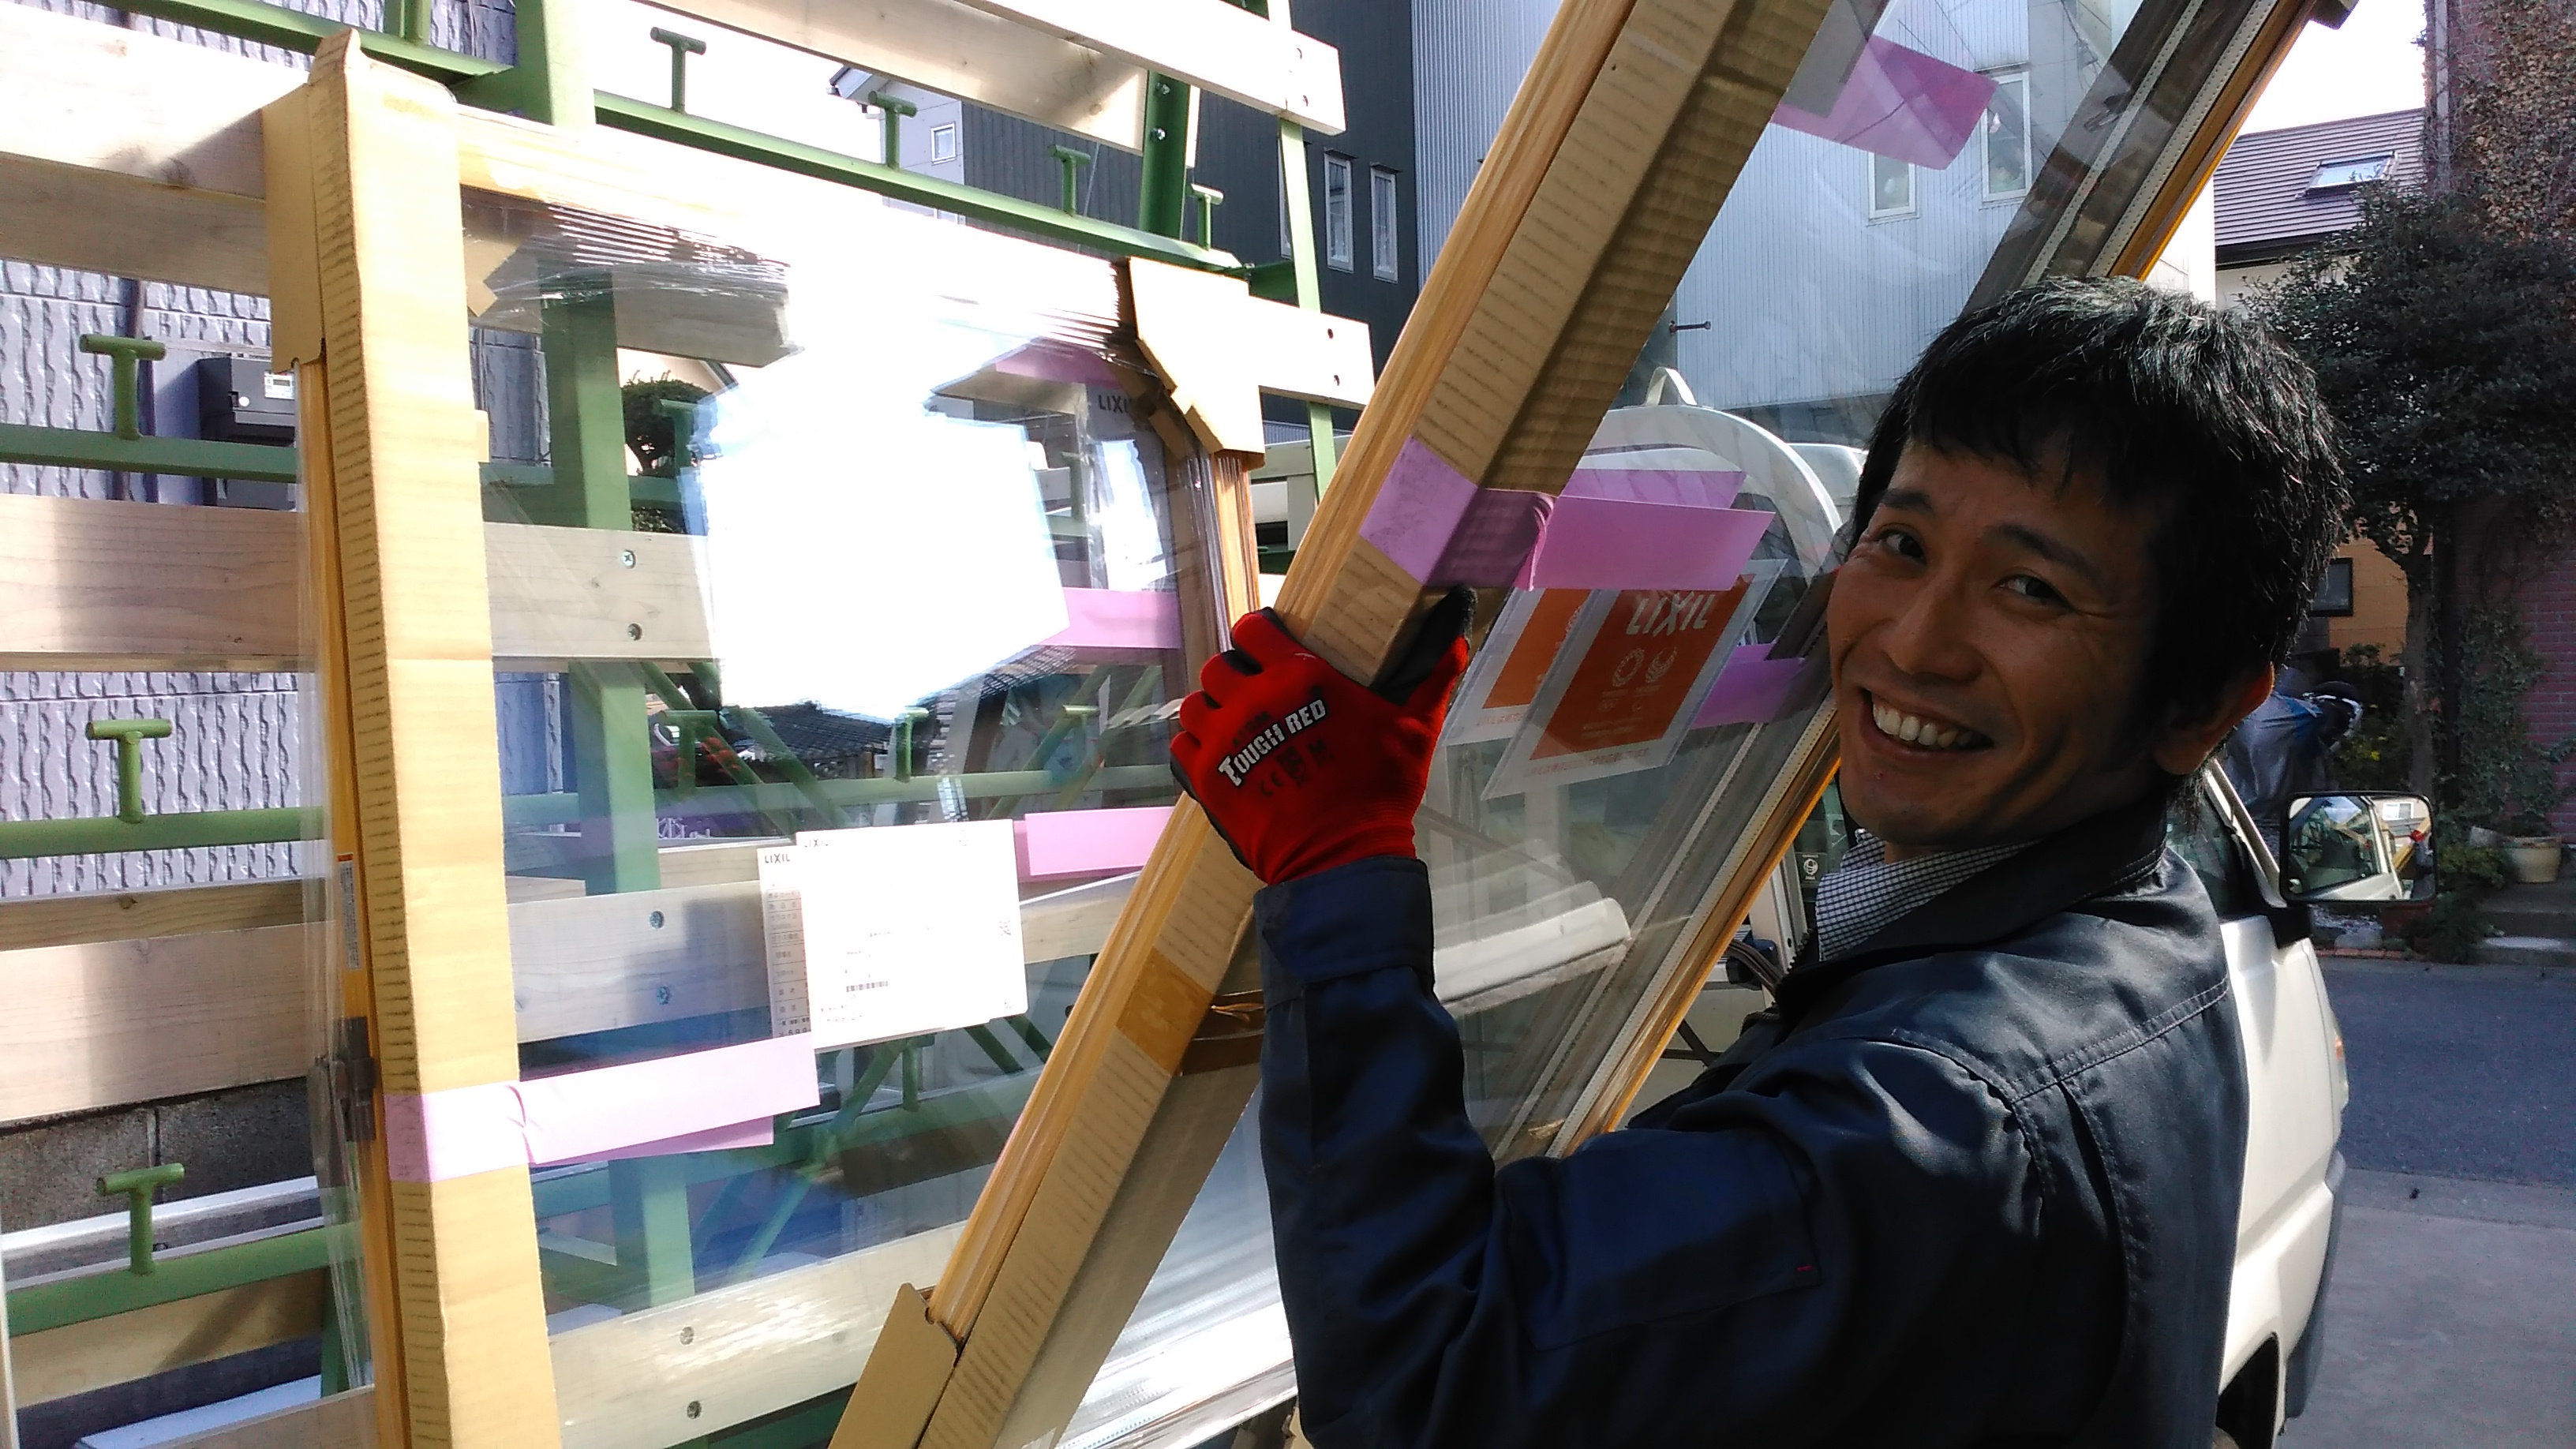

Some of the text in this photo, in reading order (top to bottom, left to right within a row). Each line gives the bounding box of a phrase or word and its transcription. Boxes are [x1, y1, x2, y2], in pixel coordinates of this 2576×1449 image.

[1625, 591, 1716, 637] LIXIL
[1217, 723, 1286, 788] TOUGH
[1284, 698, 1327, 735] RED
[764, 852, 791, 864] LIXIL
